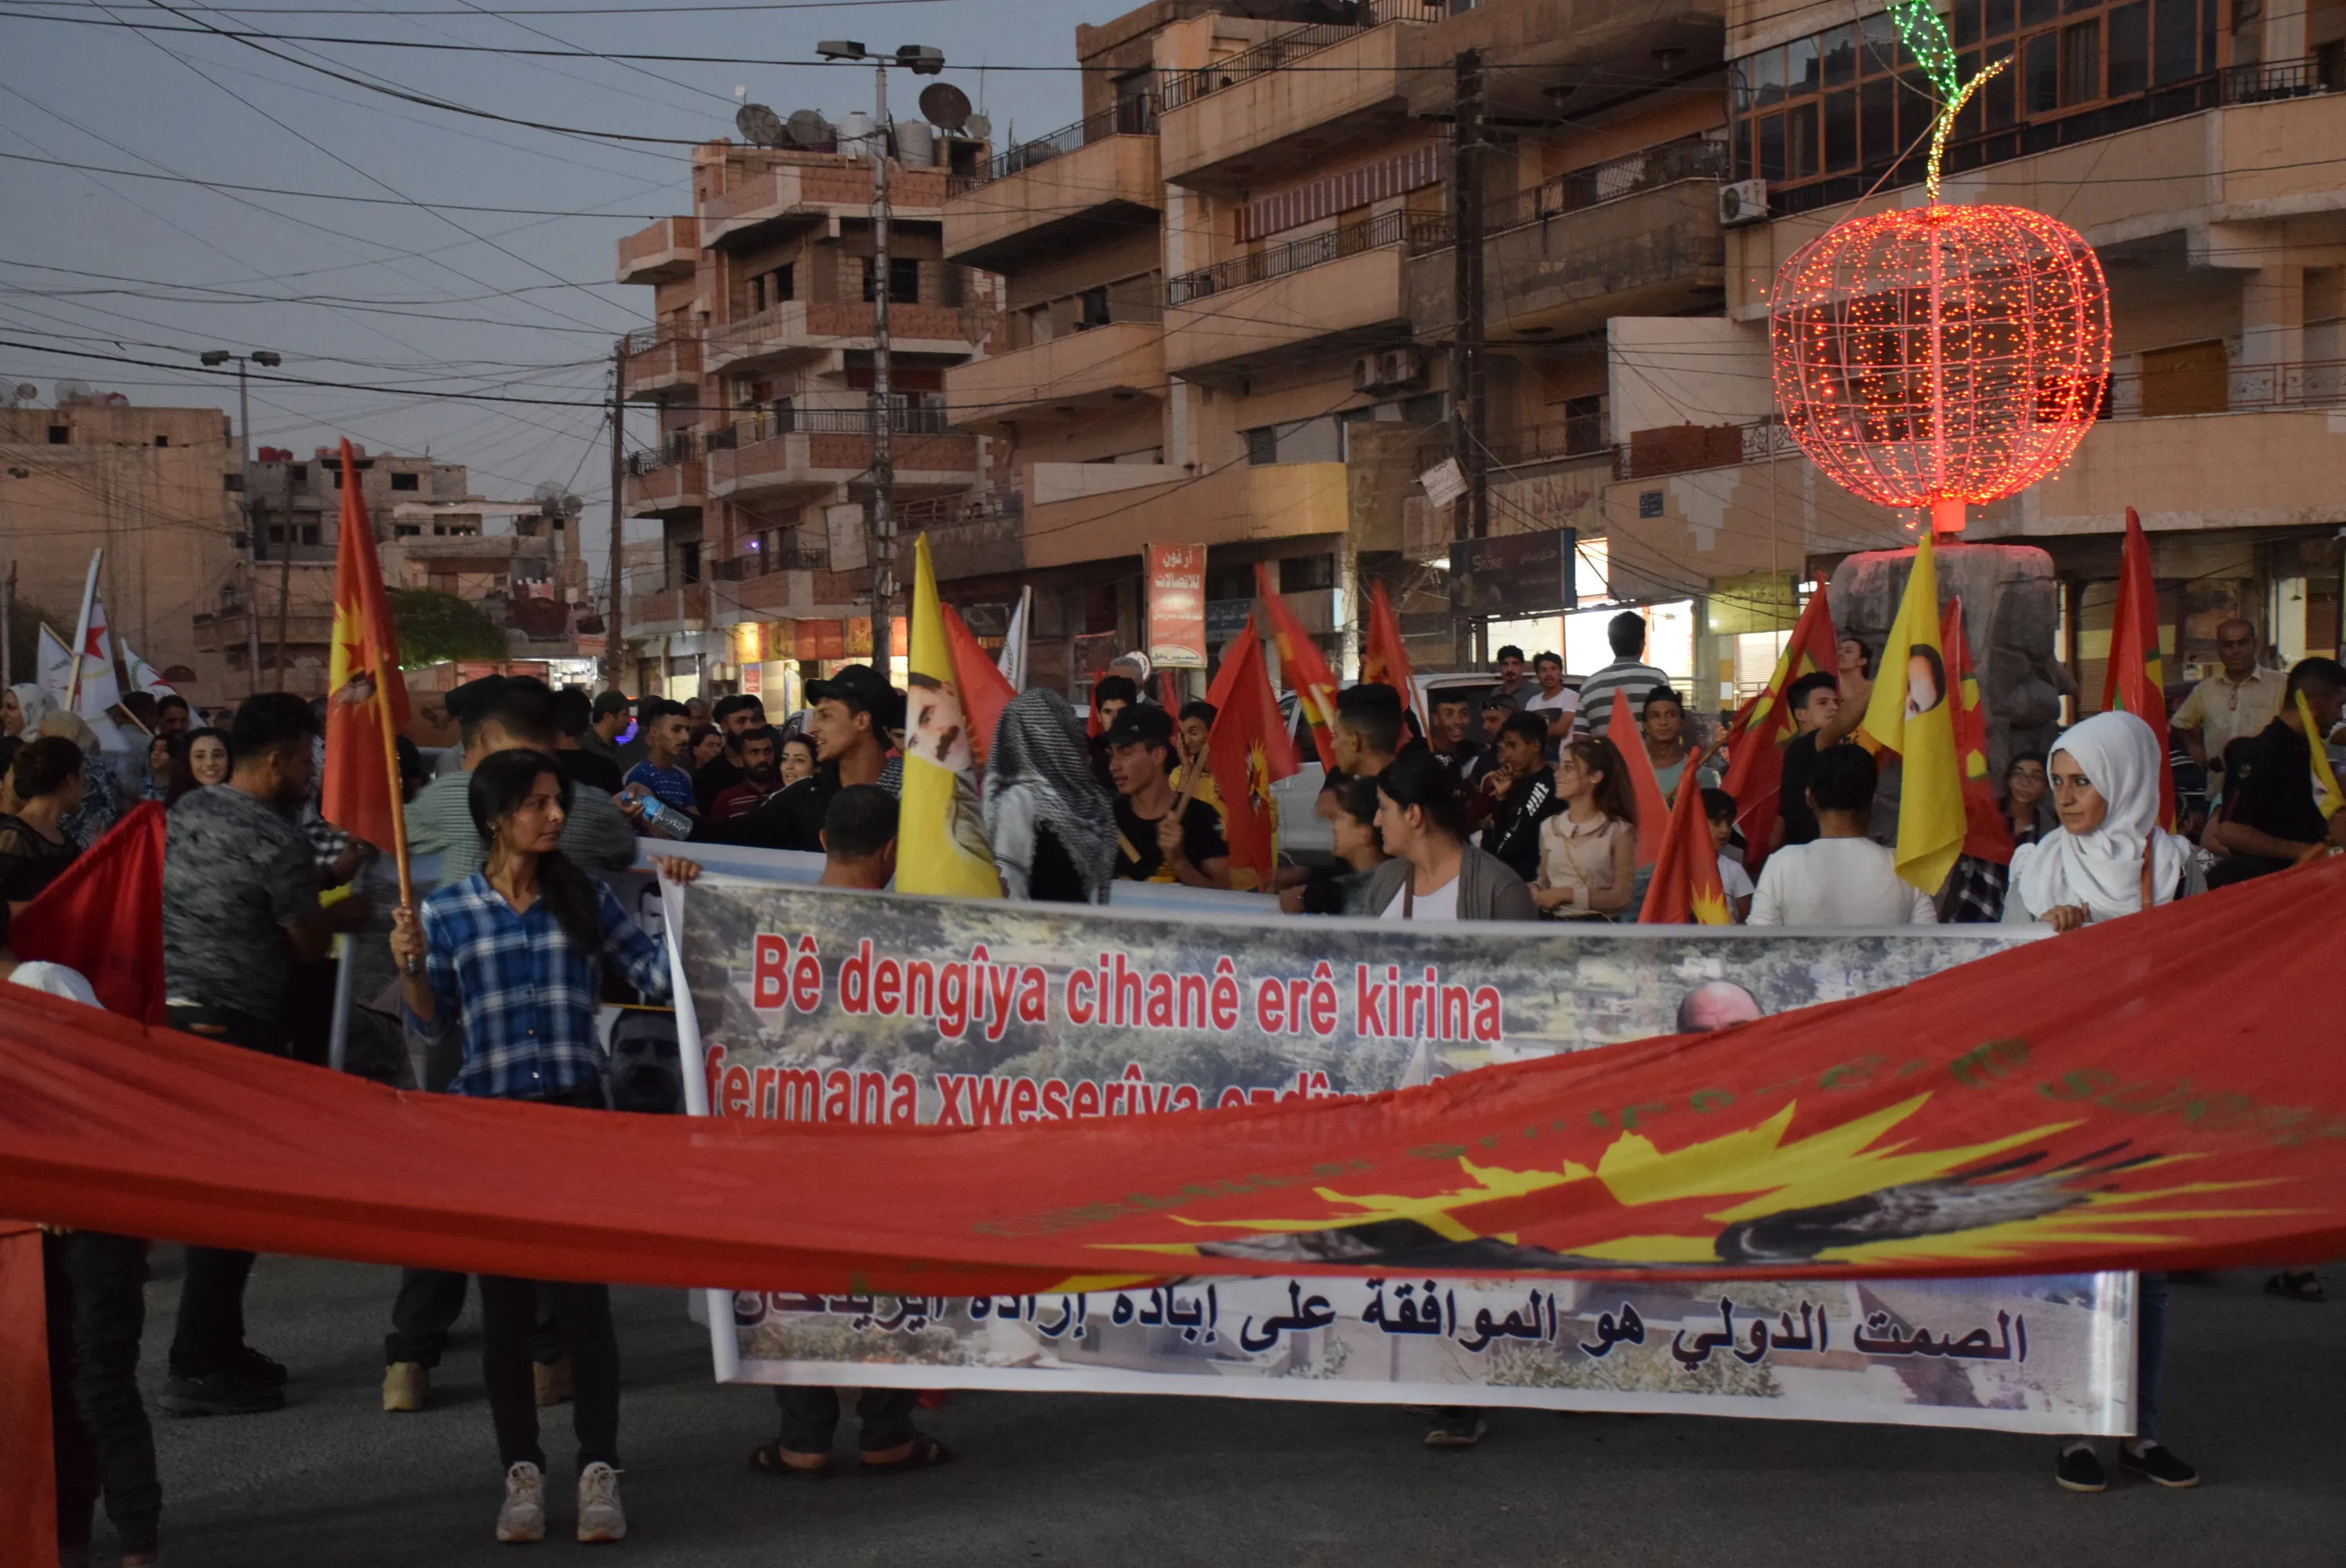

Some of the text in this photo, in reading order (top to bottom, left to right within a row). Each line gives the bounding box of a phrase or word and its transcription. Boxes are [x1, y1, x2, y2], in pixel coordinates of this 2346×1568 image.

[1525, 782, 1550, 817] NIKE
[754, 934, 1502, 1041] Bê dengîya cihanê erê kirina
[706, 1044, 917, 1123] fermana
[1239, 1279, 1336, 1352] على
[1361, 1278, 1558, 1353] الموافقة
[1578, 1301, 1646, 1358] هو
[1672, 1295, 1828, 1371] الدولي
[1854, 1308, 2028, 1363] الصمت
